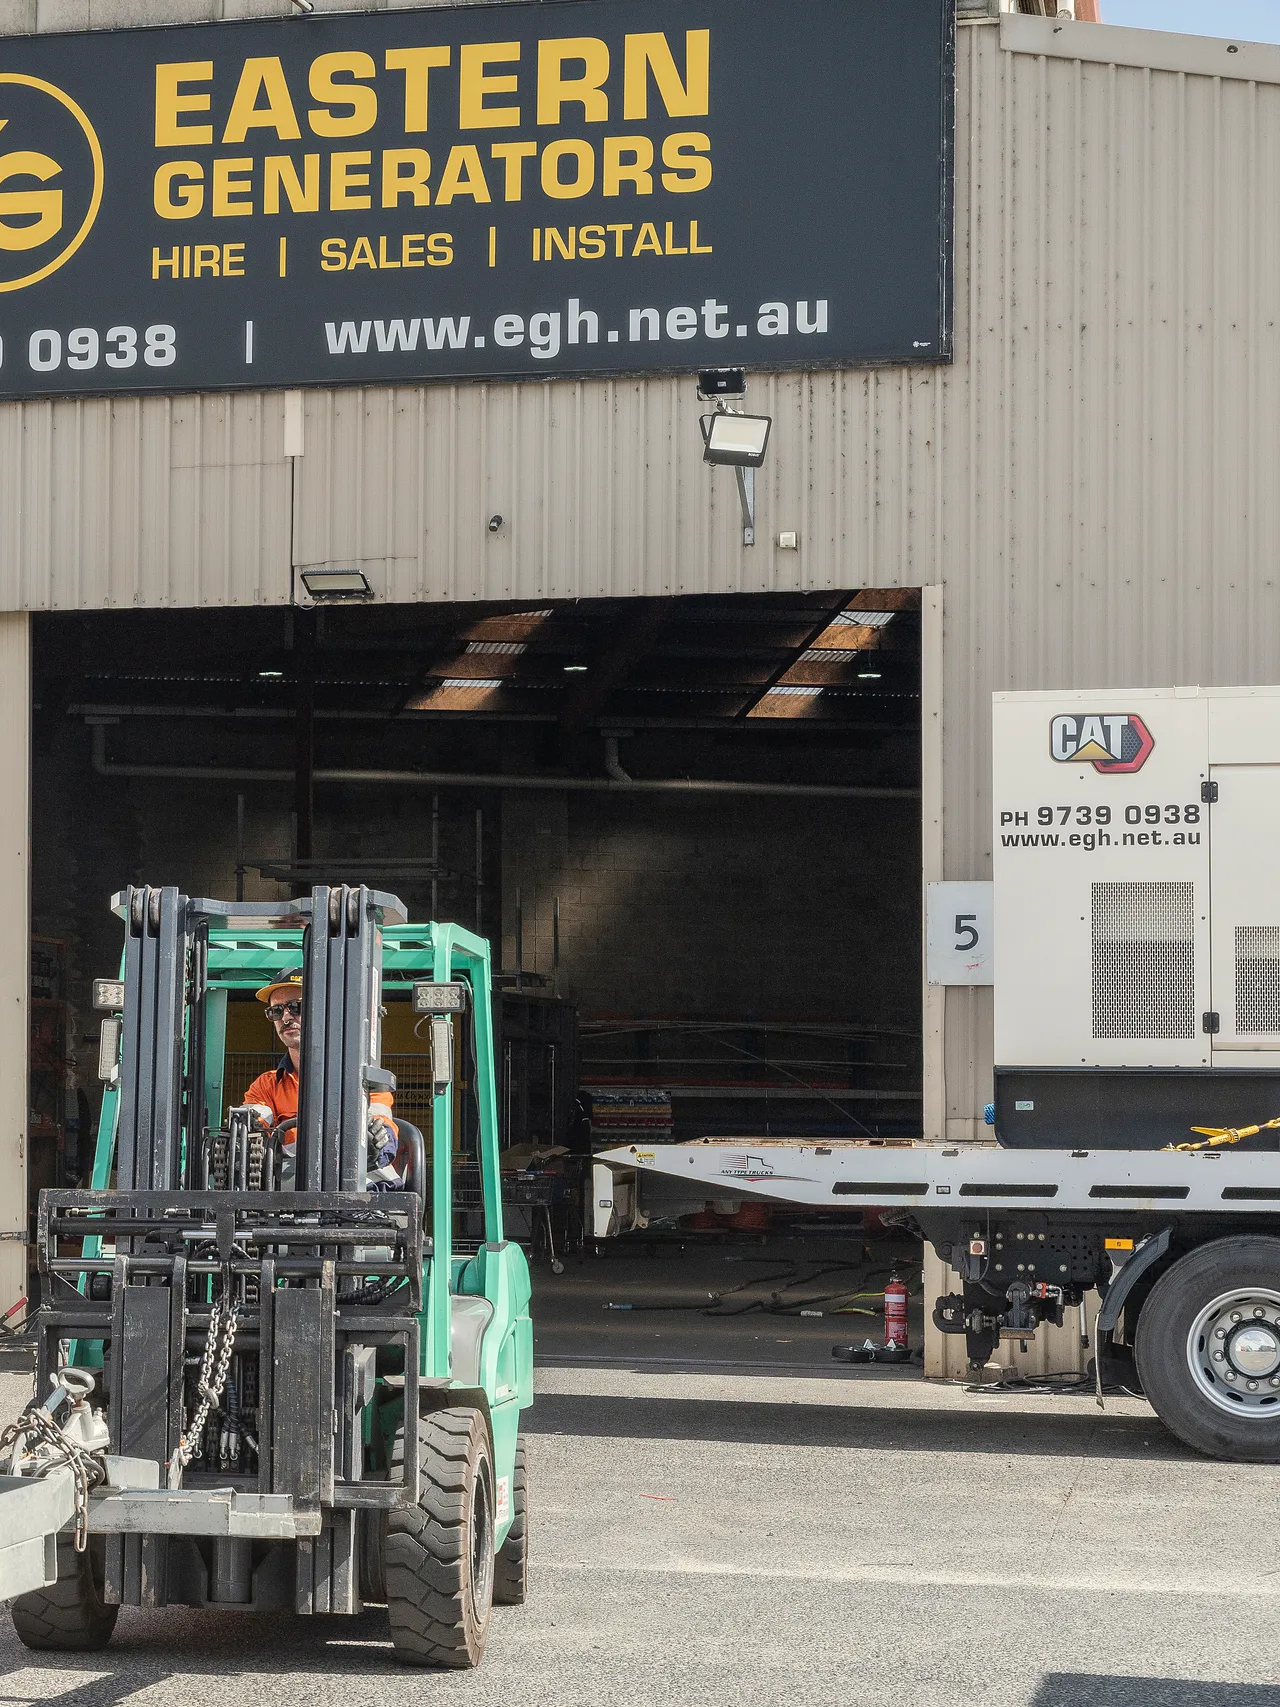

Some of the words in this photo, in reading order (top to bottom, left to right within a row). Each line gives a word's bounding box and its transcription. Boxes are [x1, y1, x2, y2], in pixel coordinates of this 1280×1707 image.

[154, 28, 711, 148] EASTERN
[153, 131, 713, 219] GENERATORS
[152, 243, 245, 279] HIRE
[320, 232, 454, 272] SALES
[532, 220, 713, 261] INSTALL
[28, 324, 177, 372] 0938
[324, 298, 828, 359] www.egh.net.au
[1052, 715, 1129, 760] CAT
[1000, 811, 1028, 827] PH
[1037, 805, 1111, 826] 9739
[1124, 804, 1200, 825] 0938
[1000, 829, 1201, 852] www.egh.net.au
[954, 914, 979, 951] 5
